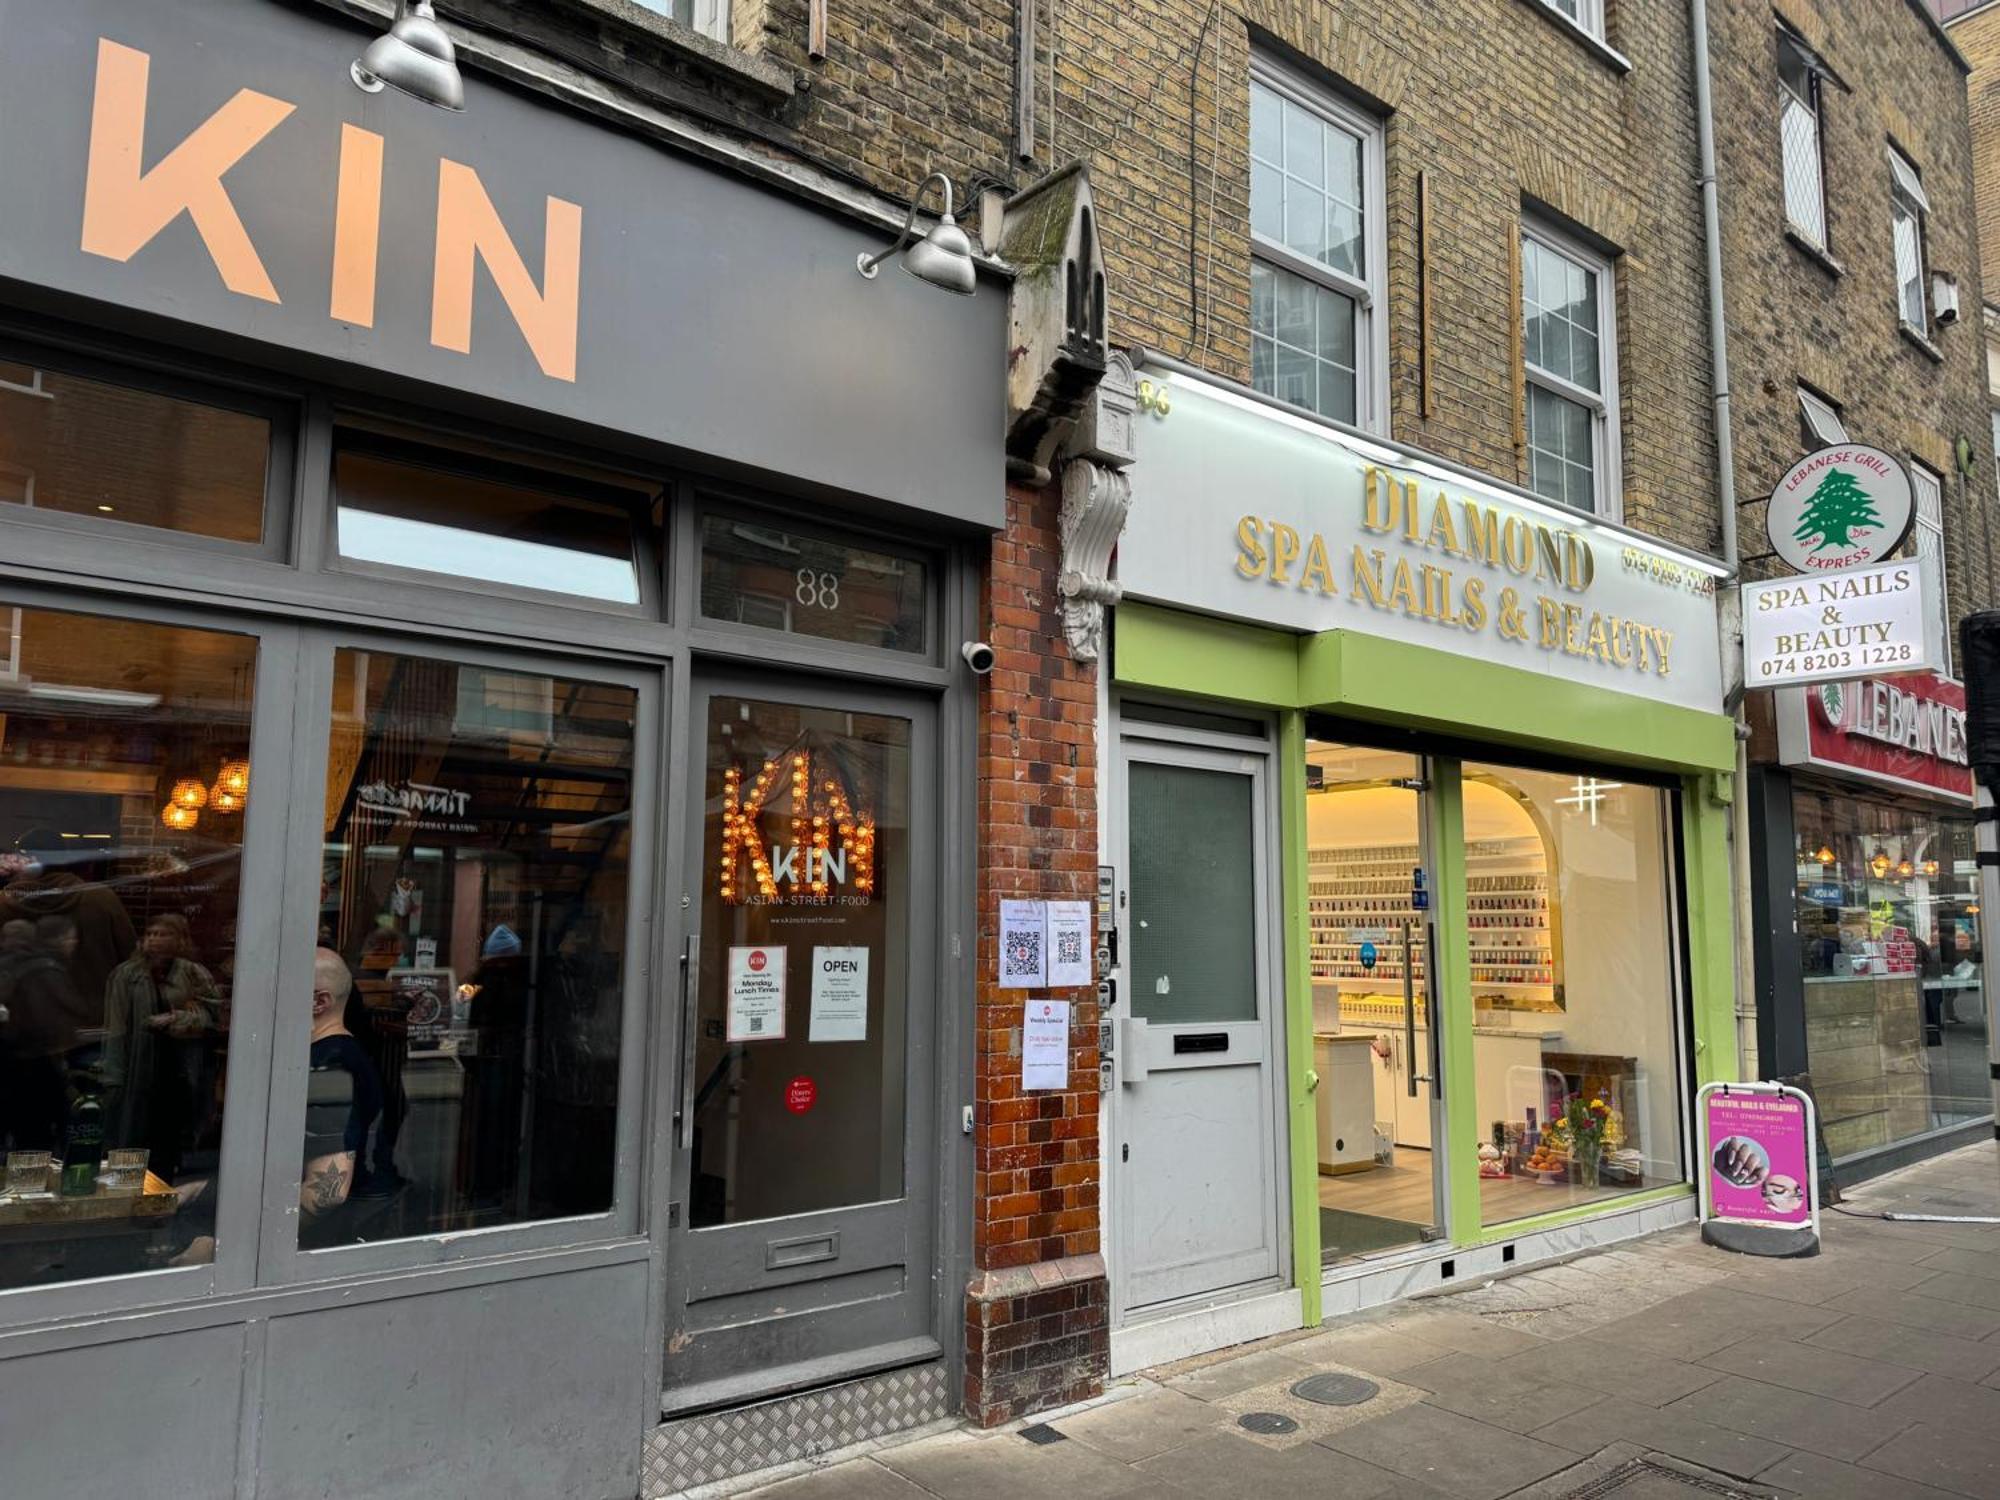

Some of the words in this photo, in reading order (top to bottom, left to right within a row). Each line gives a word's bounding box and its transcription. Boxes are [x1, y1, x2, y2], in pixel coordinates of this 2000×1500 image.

[81, 37, 581, 383] KIN
[1786, 452, 1852, 491] LEBANESE
[1855, 453, 1891, 478] GRILL
[1363, 464, 1594, 593] DIAMOND
[1799, 536, 1821, 548] HALAL
[1805, 547, 1871, 569] EXPRESS
[796, 568, 839, 609] 88
[1236, 515, 1338, 594] SPA
[1350, 544, 1487, 630] NAILS
[1499, 586, 1530, 641] &
[1537, 595, 1674, 677] BEAUTY
[1758, 586, 1810, 612] SPA
[1818, 570, 1911, 602] NAILS
[1821, 605, 1843, 626] &
[1775, 621, 1894, 655] BEAUTY
[1761, 658, 1796, 676] 074
[1803, 652, 1851, 672] 8203
[1862, 645, 1912, 665] 1228
[773, 845, 846, 884] KIN
[823, 960, 858, 973] OPEN
[734, 987, 757, 995] Lunch
[742, 980, 772, 988] Monday
